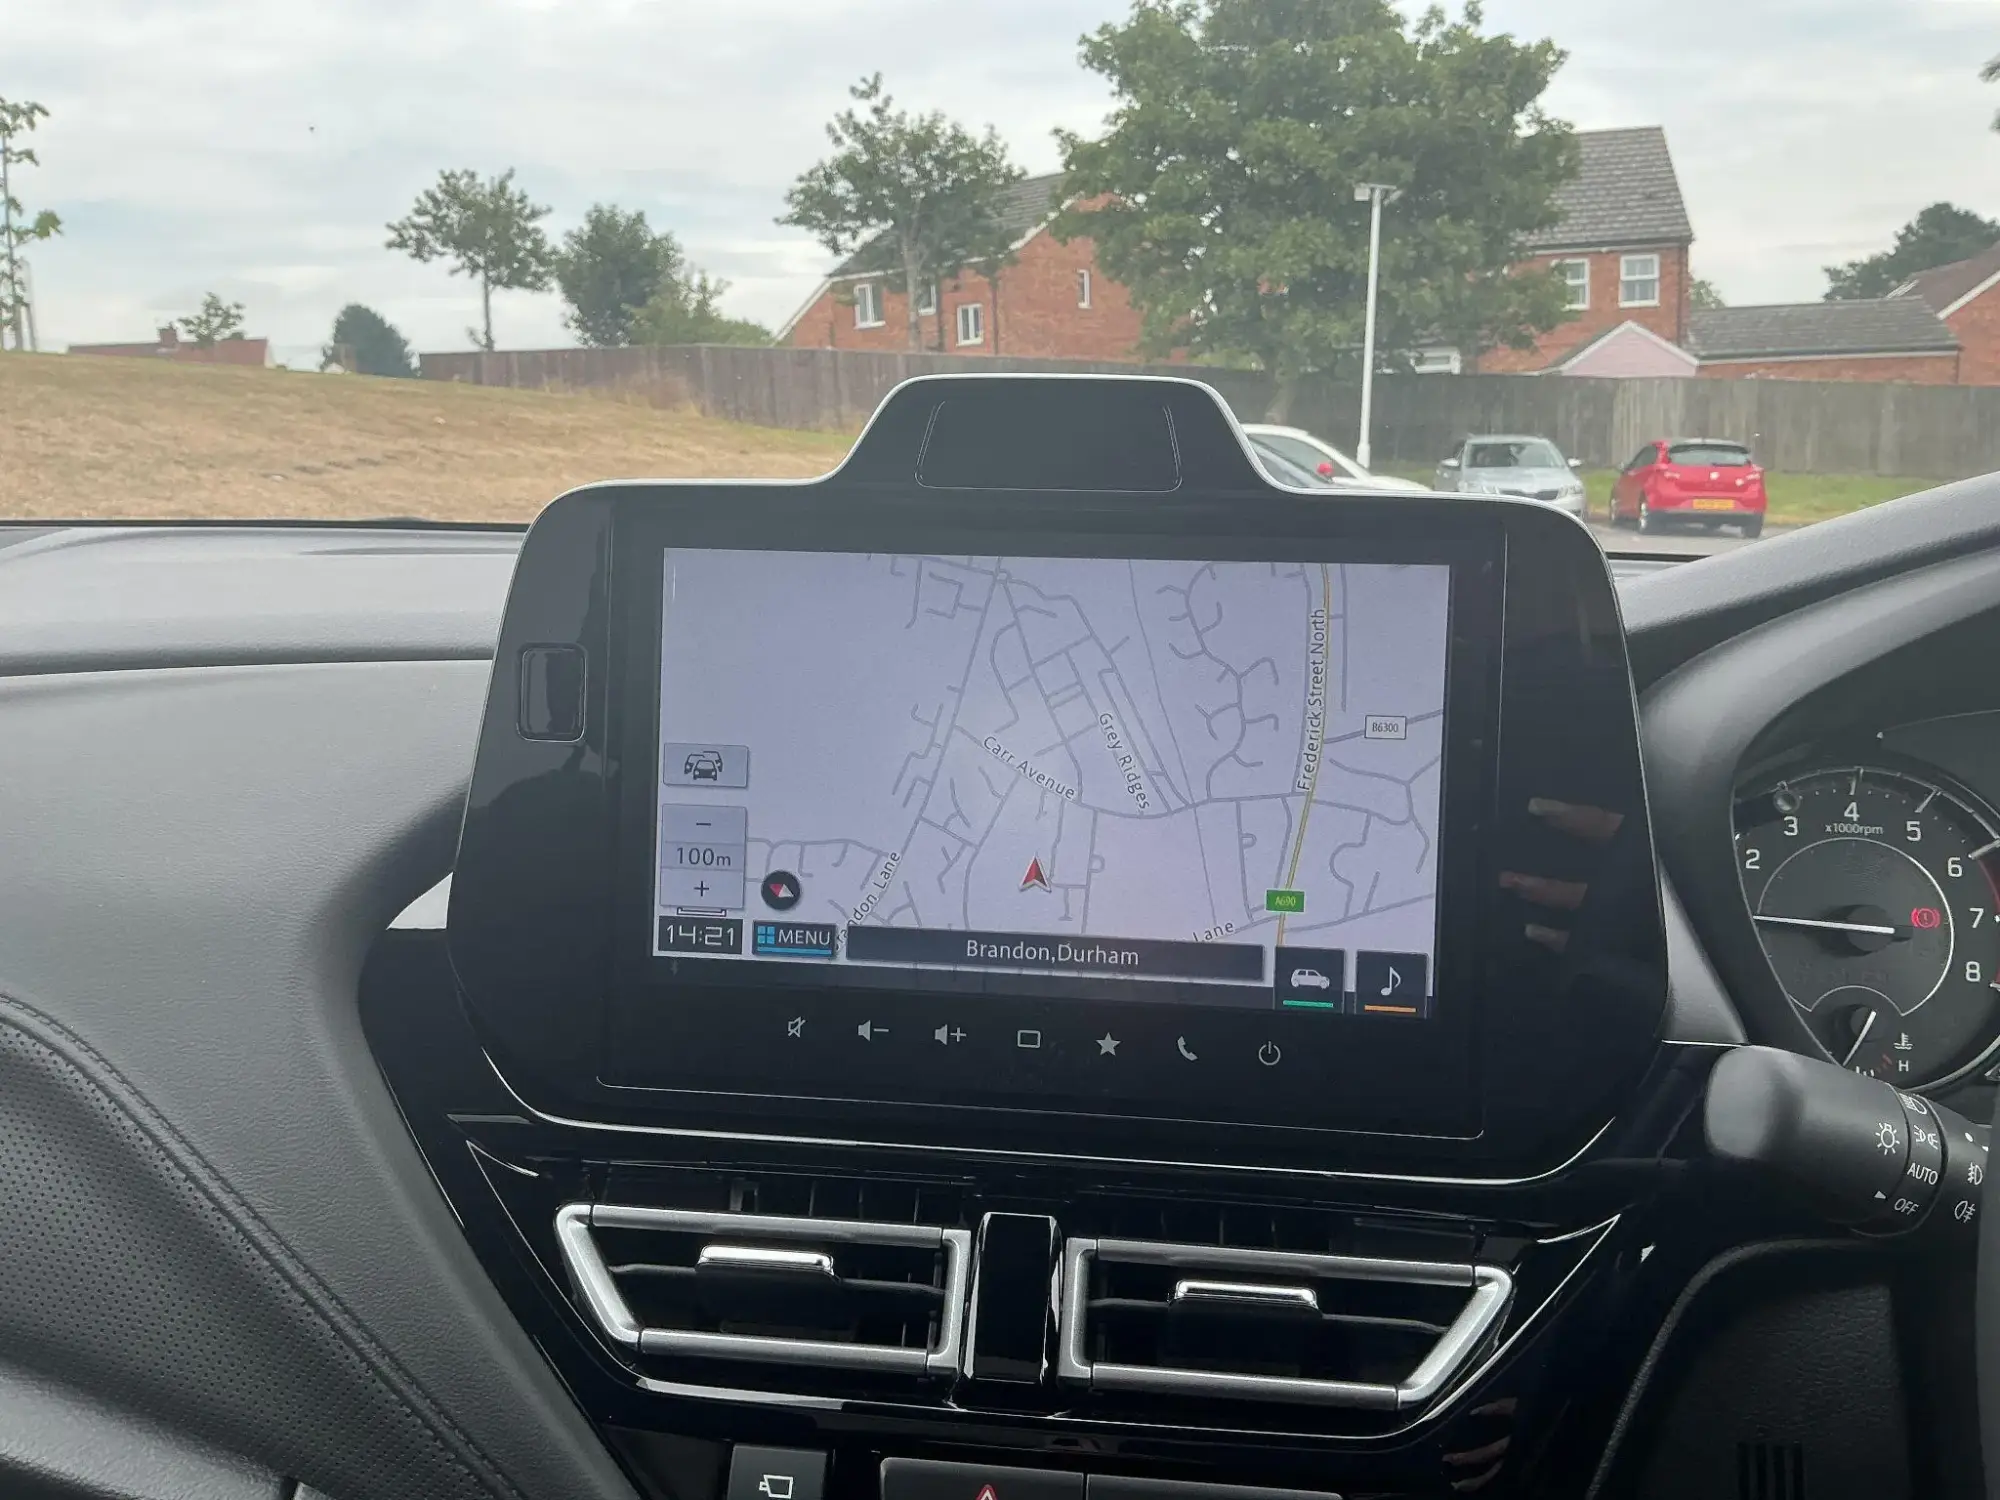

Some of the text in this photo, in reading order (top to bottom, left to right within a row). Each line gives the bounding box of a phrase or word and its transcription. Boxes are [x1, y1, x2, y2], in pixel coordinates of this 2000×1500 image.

[1297, 608, 1325, 790] Frederick Street North
[1372, 721, 1399, 733] B6300
[983, 736, 1075, 799] Carr Avenue
[1098, 711, 1150, 810] Grey Ridges
[1843, 801, 1860, 822] 4
[1783, 815, 1799, 837] 3
[1824, 822, 1884, 836] x1000rpm
[1905, 820, 1922, 842] 5
[676, 846, 732, 867] 100m
[1745, 848, 1761, 870] 2
[1947, 856, 1963, 878] 6
[835, 851, 901, 951] randon Lane
[1969, 907, 1985, 929] 7
[666, 923, 736, 947] 14:21
[777, 929, 831, 946] MENU
[966, 939, 1140, 966] Brandon,Durham
[1964, 960, 1982, 983] 8
[1898, 1059, 1909, 1072] H
[1906, 1162, 1939, 1185] AUTO
[1893, 1198, 1920, 1216] OFF
